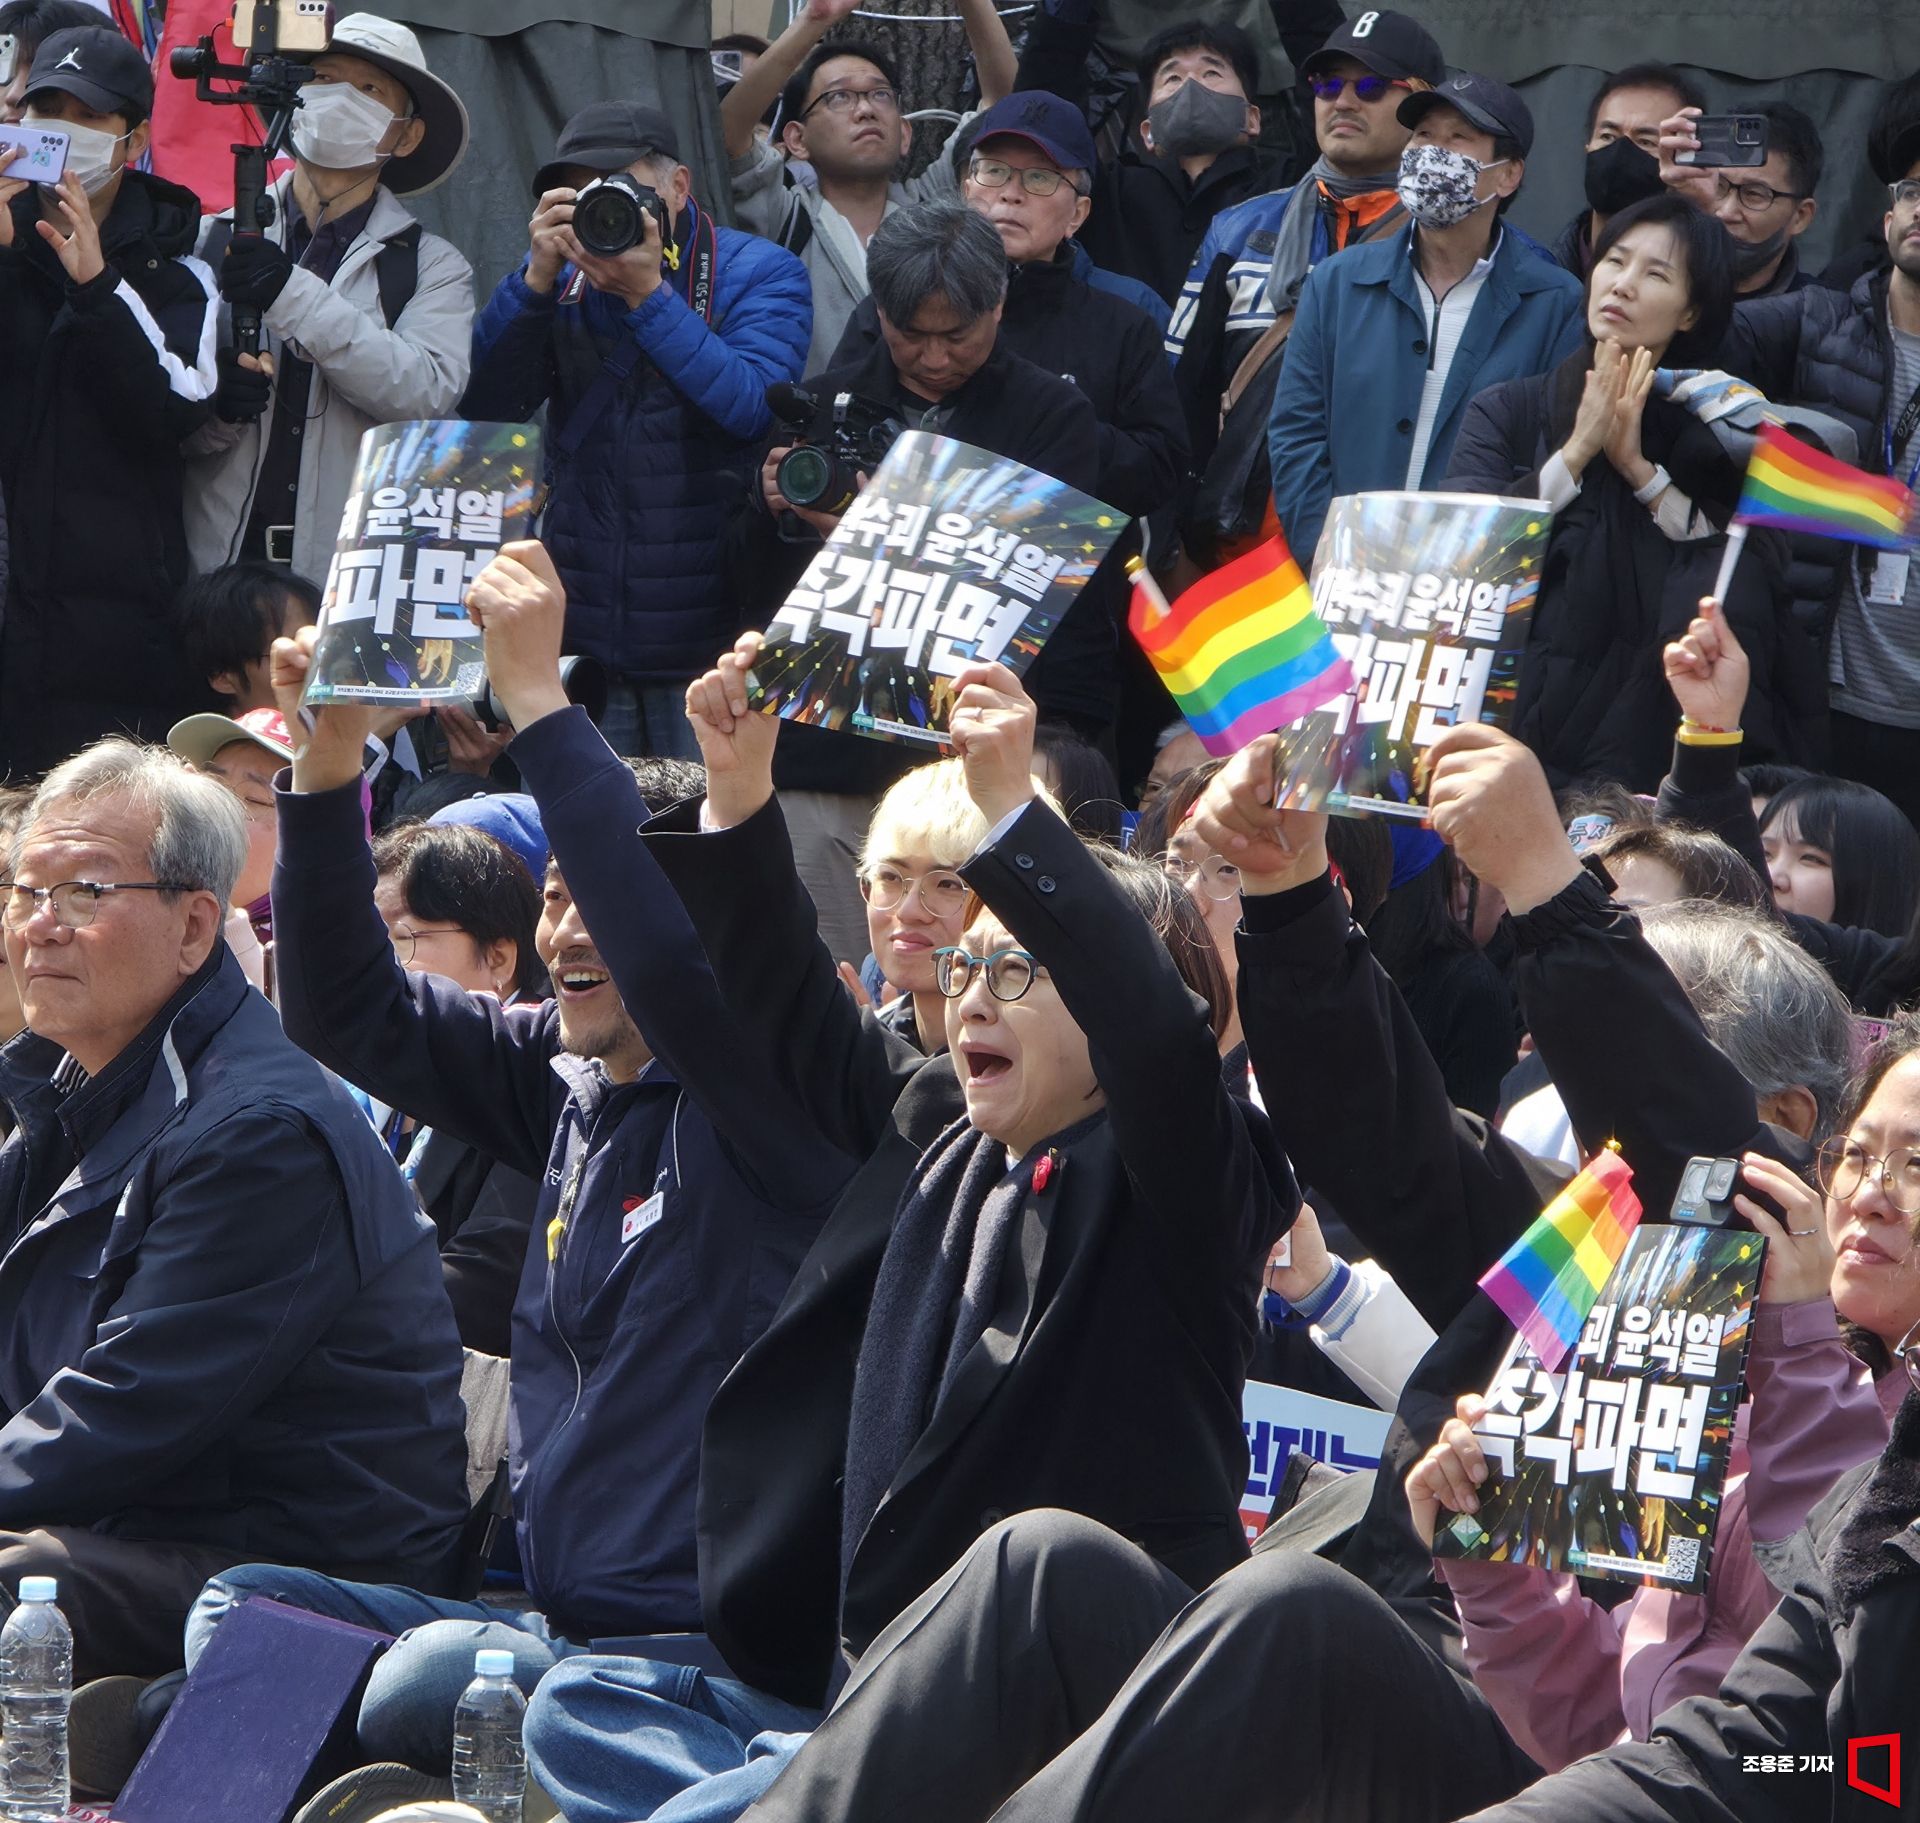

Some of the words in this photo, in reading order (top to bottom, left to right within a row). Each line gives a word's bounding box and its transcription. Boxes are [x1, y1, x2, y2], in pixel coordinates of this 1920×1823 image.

[1352, 11, 1380, 37] B
[367, 487, 505, 543] 윤석열
[922, 512, 1066, 601] 윤석열
[772, 551, 1032, 677] 즉각파면
[1402, 573, 1511, 641] 윤석열
[1613, 1305, 1725, 1377] 윤석열
[1472, 1368, 1711, 1499] 즉각파면
